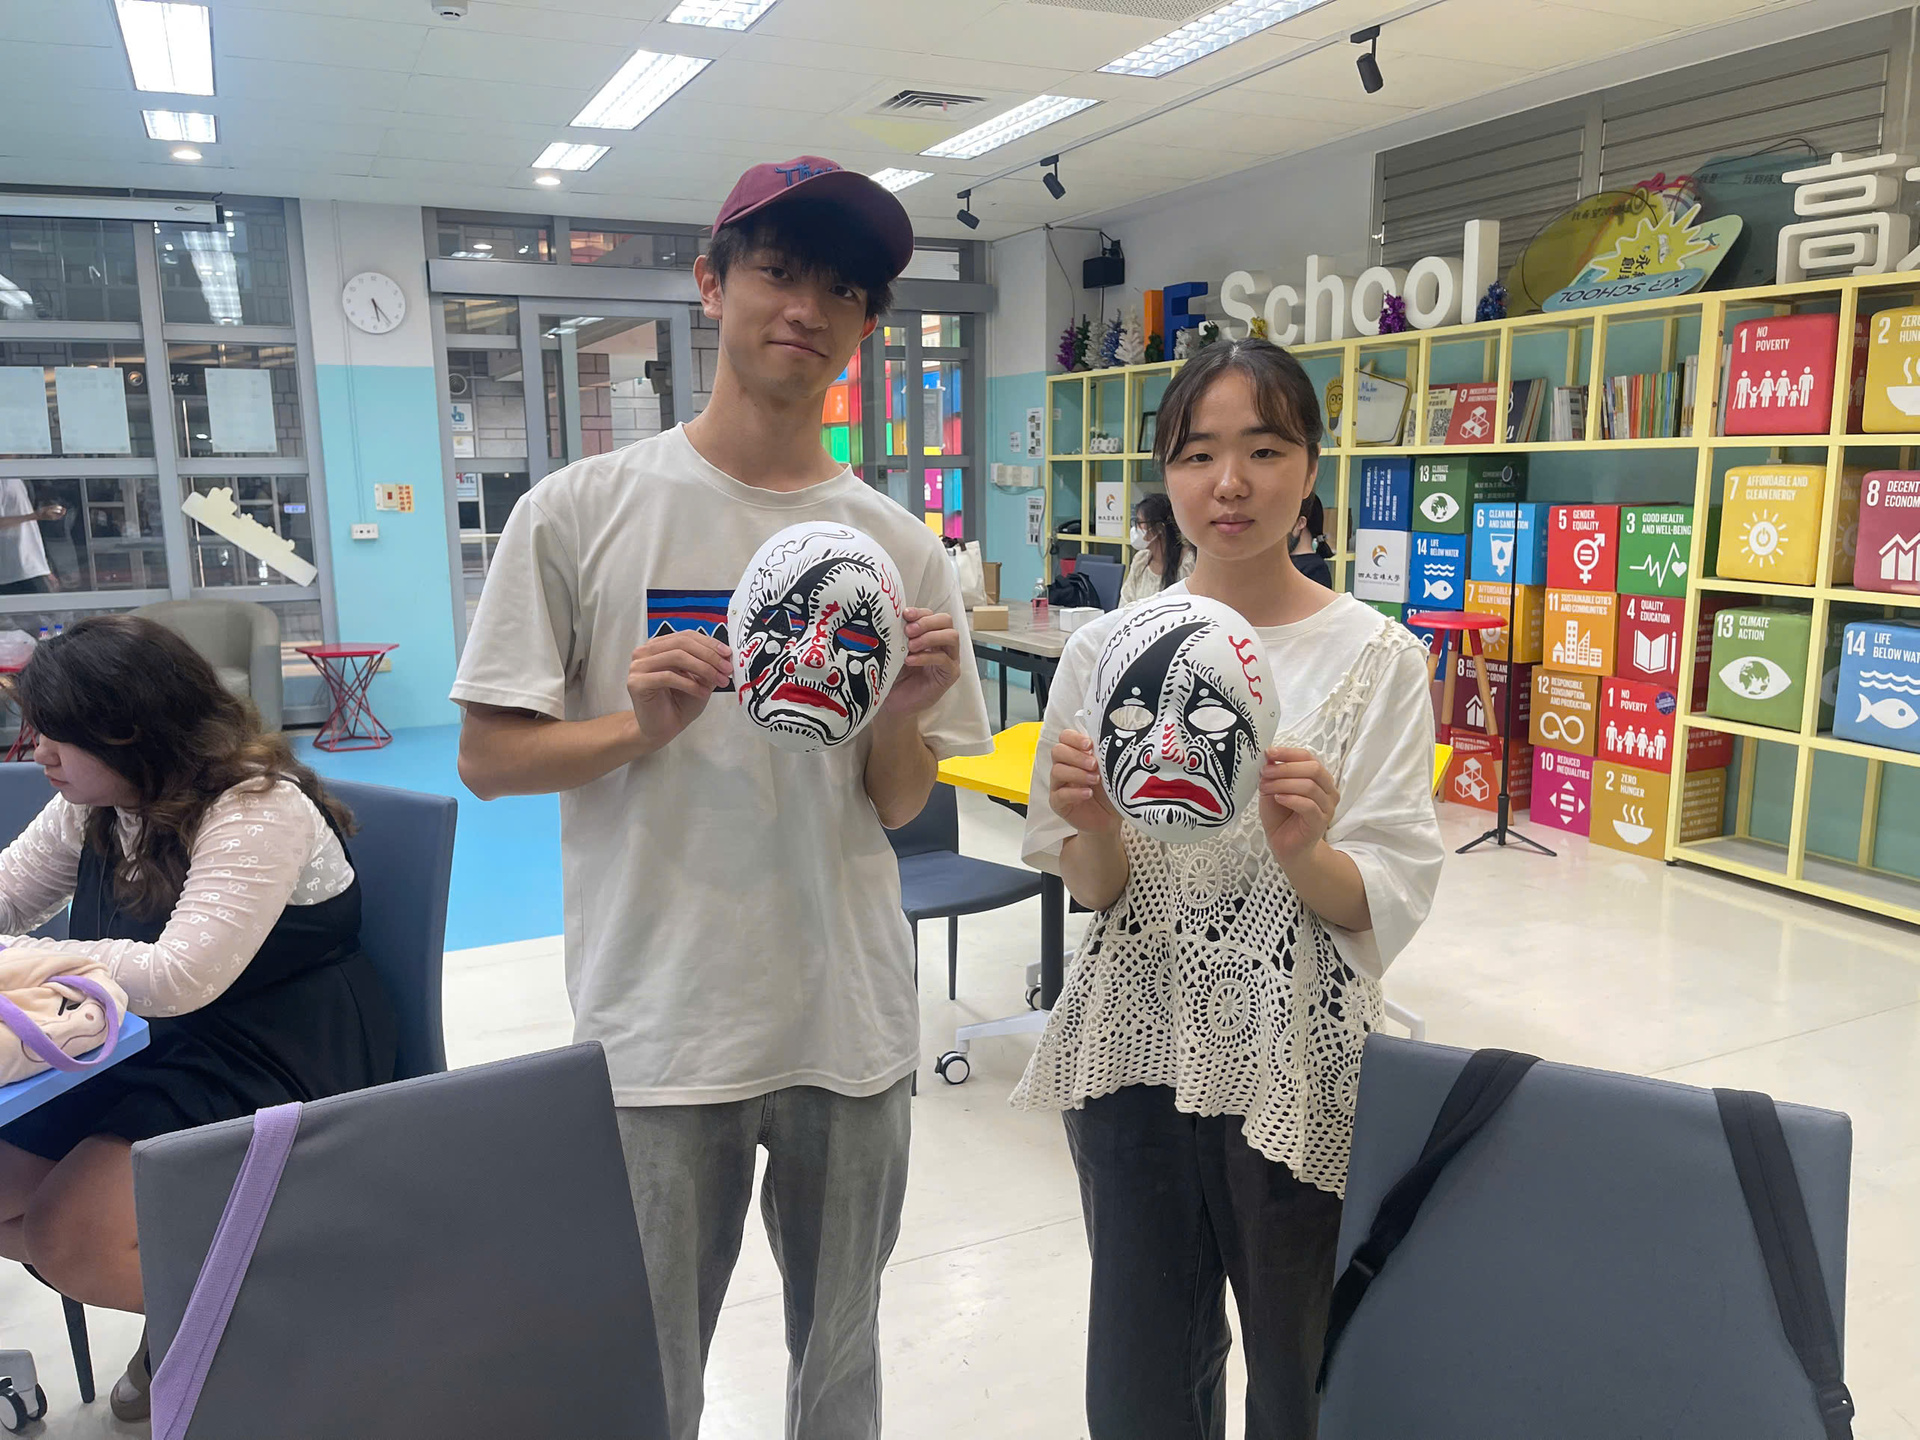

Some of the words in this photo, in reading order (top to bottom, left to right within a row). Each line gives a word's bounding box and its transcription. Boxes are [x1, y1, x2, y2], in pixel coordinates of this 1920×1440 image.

[1559, 282, 1646, 304] SCHOOL
[1740, 328, 1748, 353] 1
[1757, 326, 1768, 338] NO
[1878, 317, 1890, 344] 2
[1756, 339, 1790, 352] POVERTY
[1460, 389, 1467, 402] 9
[1420, 465, 1430, 482] 13
[1730, 476, 1740, 500] 7
[1747, 476, 1791, 487] AFFORDABLE
[1792, 476, 1808, 488] AND
[1746, 488, 1768, 500] CLEAN
[1769, 489, 1797, 501] ENERGY
[1866, 480, 1880, 506] 8
[1477, 509, 1485, 528] 6
[1489, 520, 1499, 528] AND
[1558, 509, 1567, 529] 5
[1573, 510, 1595, 519] GENDER
[1572, 521, 1599, 530] EQUALITY
[1626, 512, 1636, 533] 3
[1642, 513, 1660, 523] GOOD
[1660, 514, 1684, 523] HEALTH
[1642, 524, 1655, 534] AND
[1656, 525, 1691, 535] WELL-BEING
[1417, 538, 1427, 555] 14
[1430, 539, 1439, 547] LIFE
[1468, 584, 1475, 602] 7
[1548, 592, 1559, 611] 11
[1561, 594, 1595, 604] SUSTAINABLE
[1595, 596, 1612, 605] CITIES
[1560, 604, 1571, 613] AND
[1572, 605, 1607, 616] COMMUNITIES
[1627, 598, 1635, 619] 4
[1640, 600, 1664, 611] QUALITY
[1640, 612, 1670, 624] EDUCATION
[1716, 614, 1734, 638] 13
[1739, 616, 1770, 628] CLIMATE
[1738, 629, 1764, 641] ACTION
[1846, 630, 1866, 656] 14
[1874, 632, 1892, 645] LIFE
[1873, 646, 1902, 660] BELOW
[1458, 658, 1464, 676] 8
[1537, 676, 1549, 694] 12
[1551, 677, 1583, 690] RESPONSIBLE
[1550, 696, 1561, 705] AND
[1561, 698, 1591, 711] PRODUCTION
[1608, 687, 1614, 707] 1
[1621, 689, 1630, 699] NO
[1620, 700, 1648, 713] POVERTY
[1540, 752, 1554, 771] 10
[1557, 755, 1580, 767] REDUCED
[1556, 765, 1590, 780] INEQUALITIES
[1605, 771, 1614, 790] 2
[1621, 774, 1637, 785] ZERO
[1620, 784, 1645, 797] HUNGER
